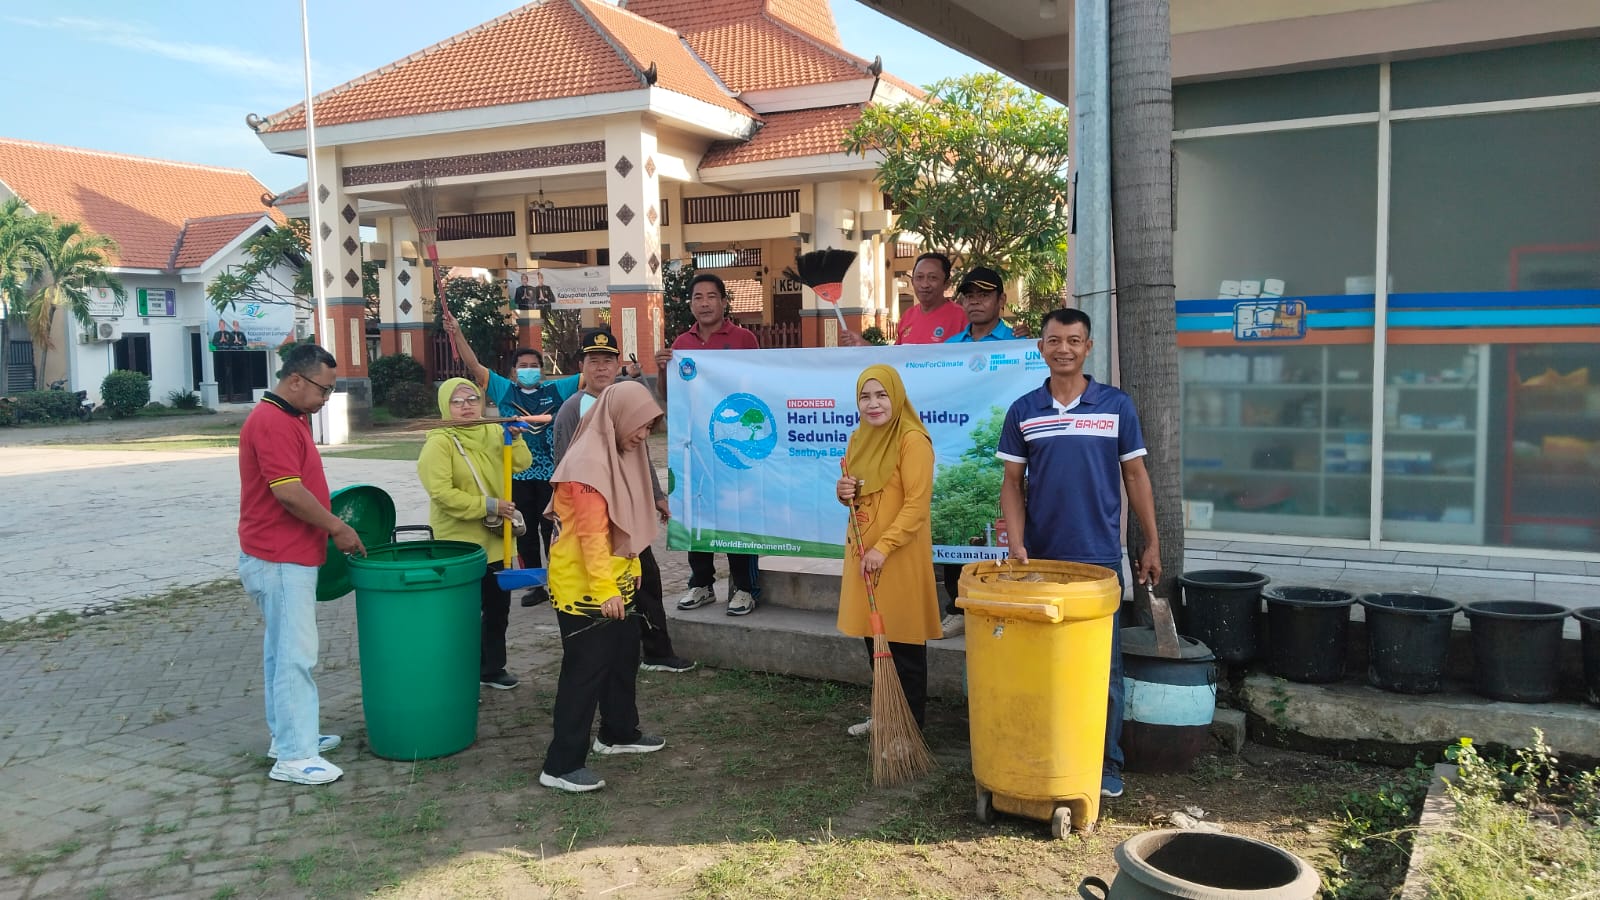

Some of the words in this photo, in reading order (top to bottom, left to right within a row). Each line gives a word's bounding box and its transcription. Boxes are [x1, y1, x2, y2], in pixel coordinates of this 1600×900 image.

[905, 361, 963, 369] #NowForClimate
[787, 412, 817, 424] Hari
[822, 411, 860, 427] Lingk
[920, 411, 969, 427] Hidup
[788, 430, 847, 442] Sedunia
[789, 448, 827, 459] Saatnya
[710, 540, 801, 552] #WorldEnvironmentDay
[937, 549, 998, 560] Kecamatan
